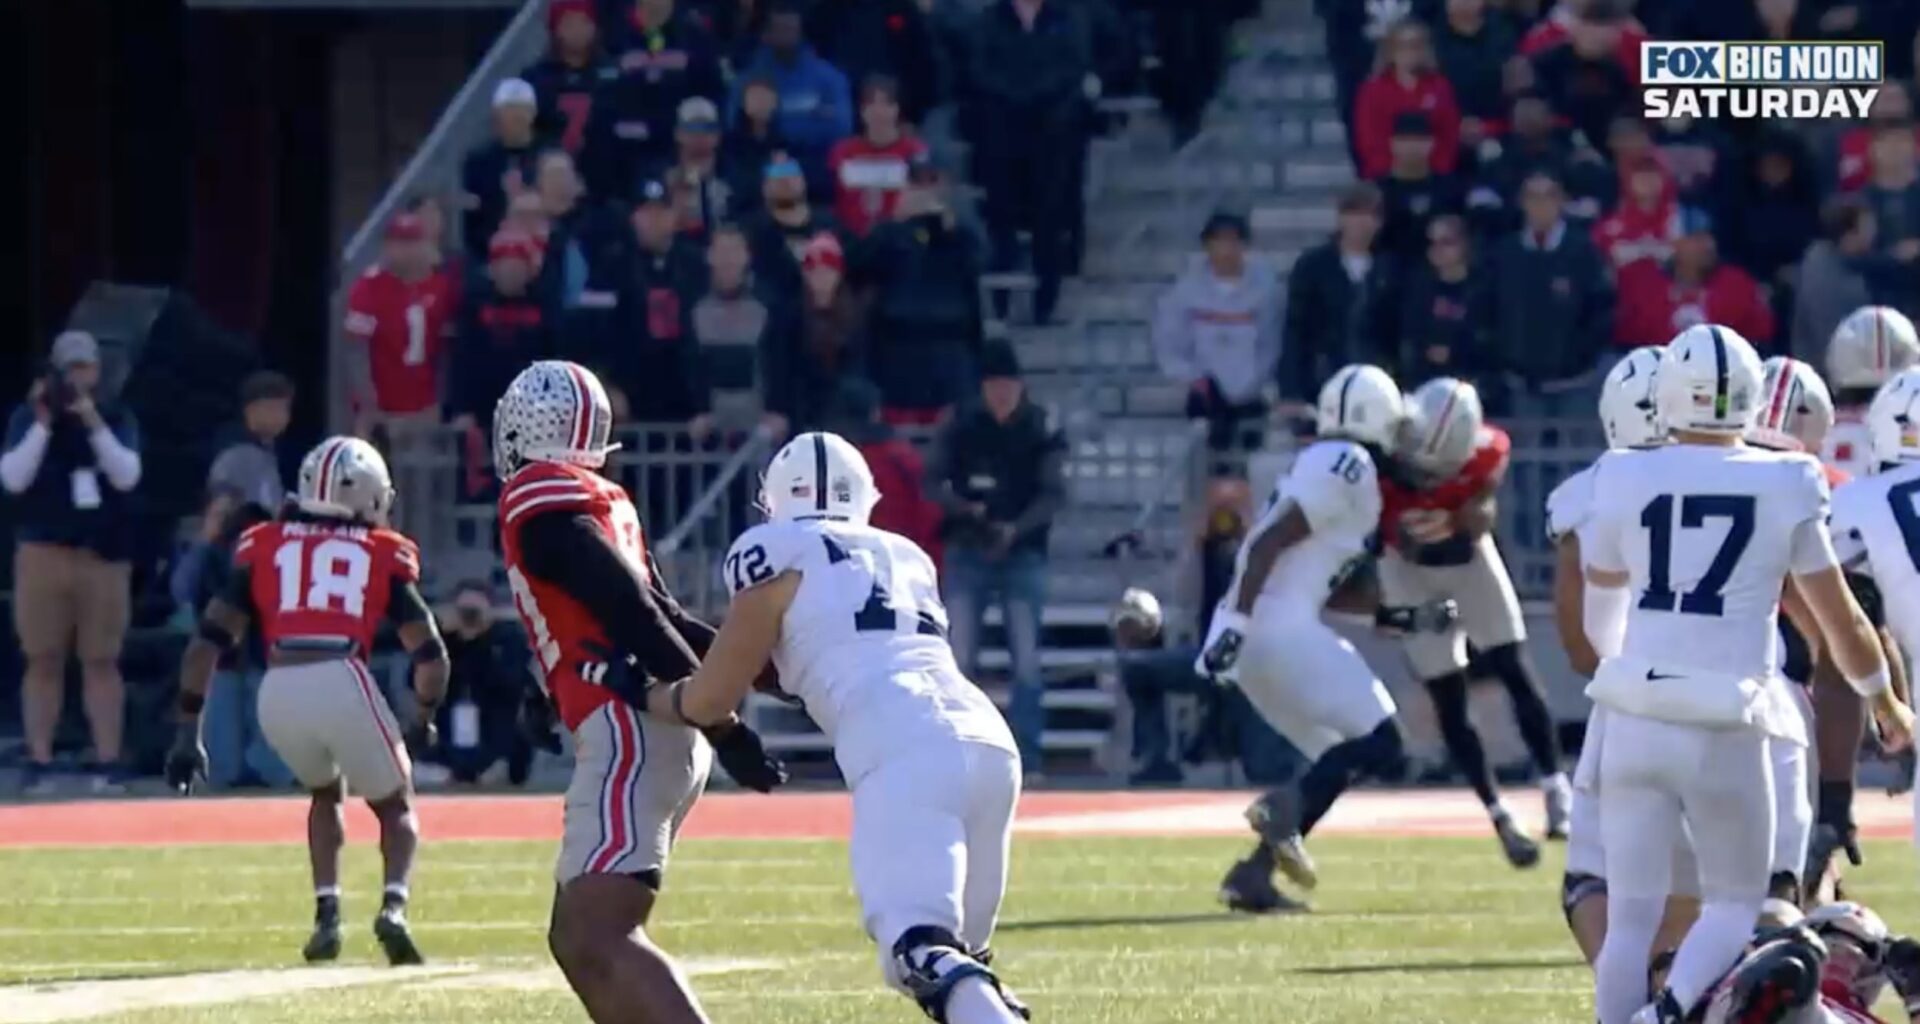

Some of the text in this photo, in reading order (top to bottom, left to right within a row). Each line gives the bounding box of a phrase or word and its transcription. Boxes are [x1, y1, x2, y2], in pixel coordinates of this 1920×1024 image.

[557, 93, 592, 150] 7
[403, 304, 426, 367] 1
[1330, 451, 1363, 485] 16
[274, 538, 371, 618] 18
[727, 544, 775, 591] 72
[1638, 494, 1756, 616] 17
